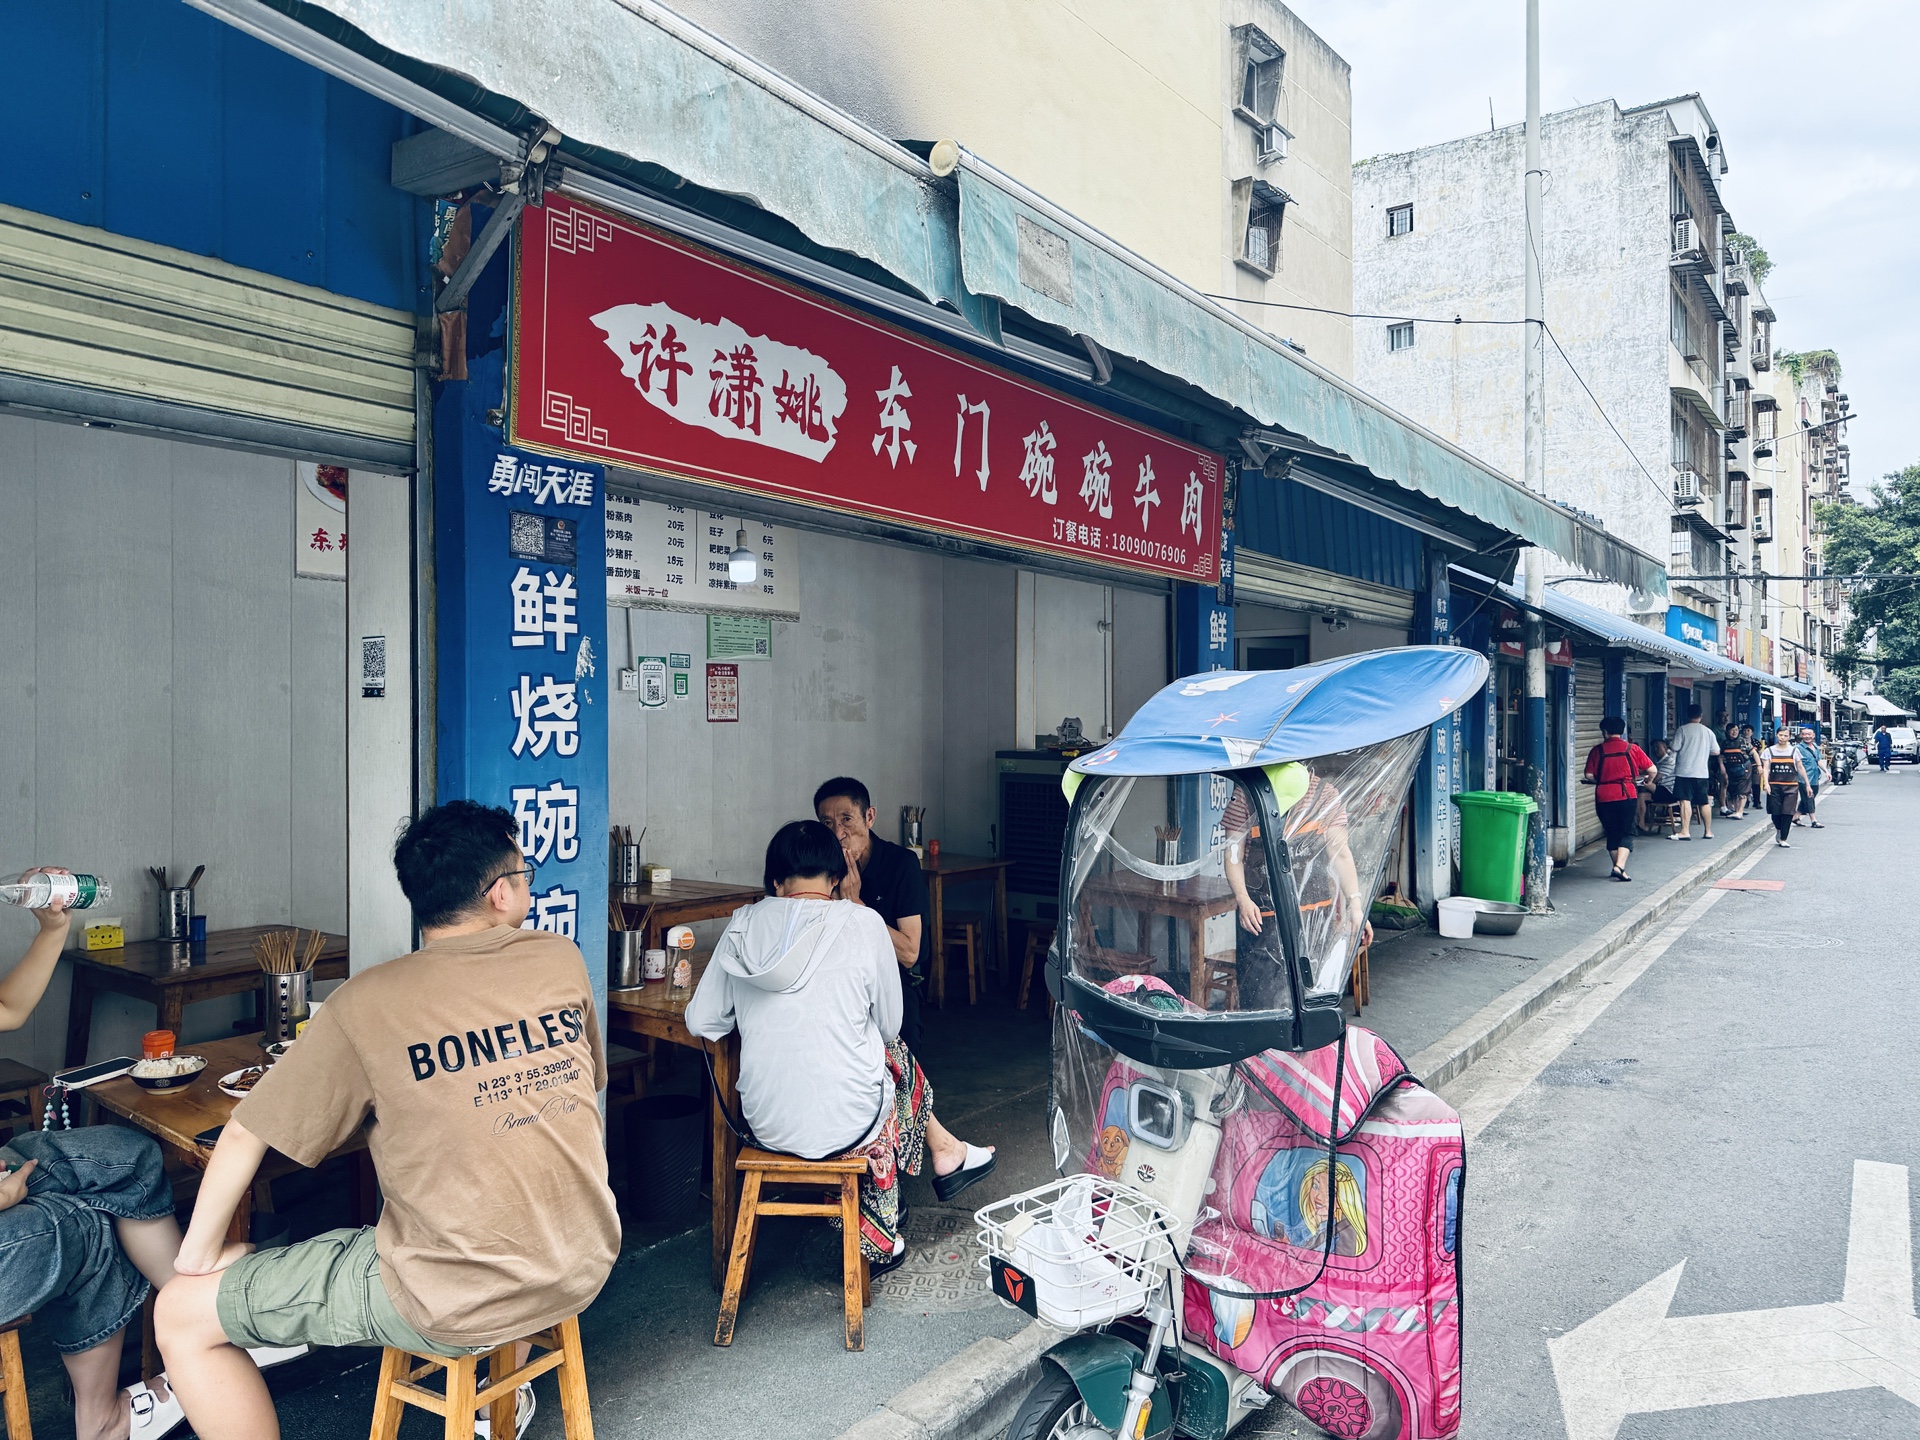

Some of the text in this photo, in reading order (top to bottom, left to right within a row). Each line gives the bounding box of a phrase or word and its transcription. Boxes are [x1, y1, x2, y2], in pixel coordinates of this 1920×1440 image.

[629, 323, 1205, 545] 许潇姚 东门碗碗牛肉
[488, 454, 594, 506] 勇闯天涯
[606, 510, 685, 531] 粉蒸肉 20元
[606, 529, 685, 549] 炒鸡杂 20元
[709, 527, 774, 545] 旺子 6元
[1053, 517, 1186, 565] 订餐电话：18090076906
[606, 547, 684, 567] 炒猪肝 18元
[762, 552, 774, 562] 6元
[606, 567, 683, 585] 番茄炒蛋 12元
[763, 568, 774, 579] 8元
[625, 585, 669, 598] 米饭一元一位
[763, 585, 774, 595] 8元
[407, 1009, 584, 1081] BONELESS
[478, 1082, 488, 1093] N
[474, 1096, 484, 1107] E
[492, 1096, 561, 1136] Brand
